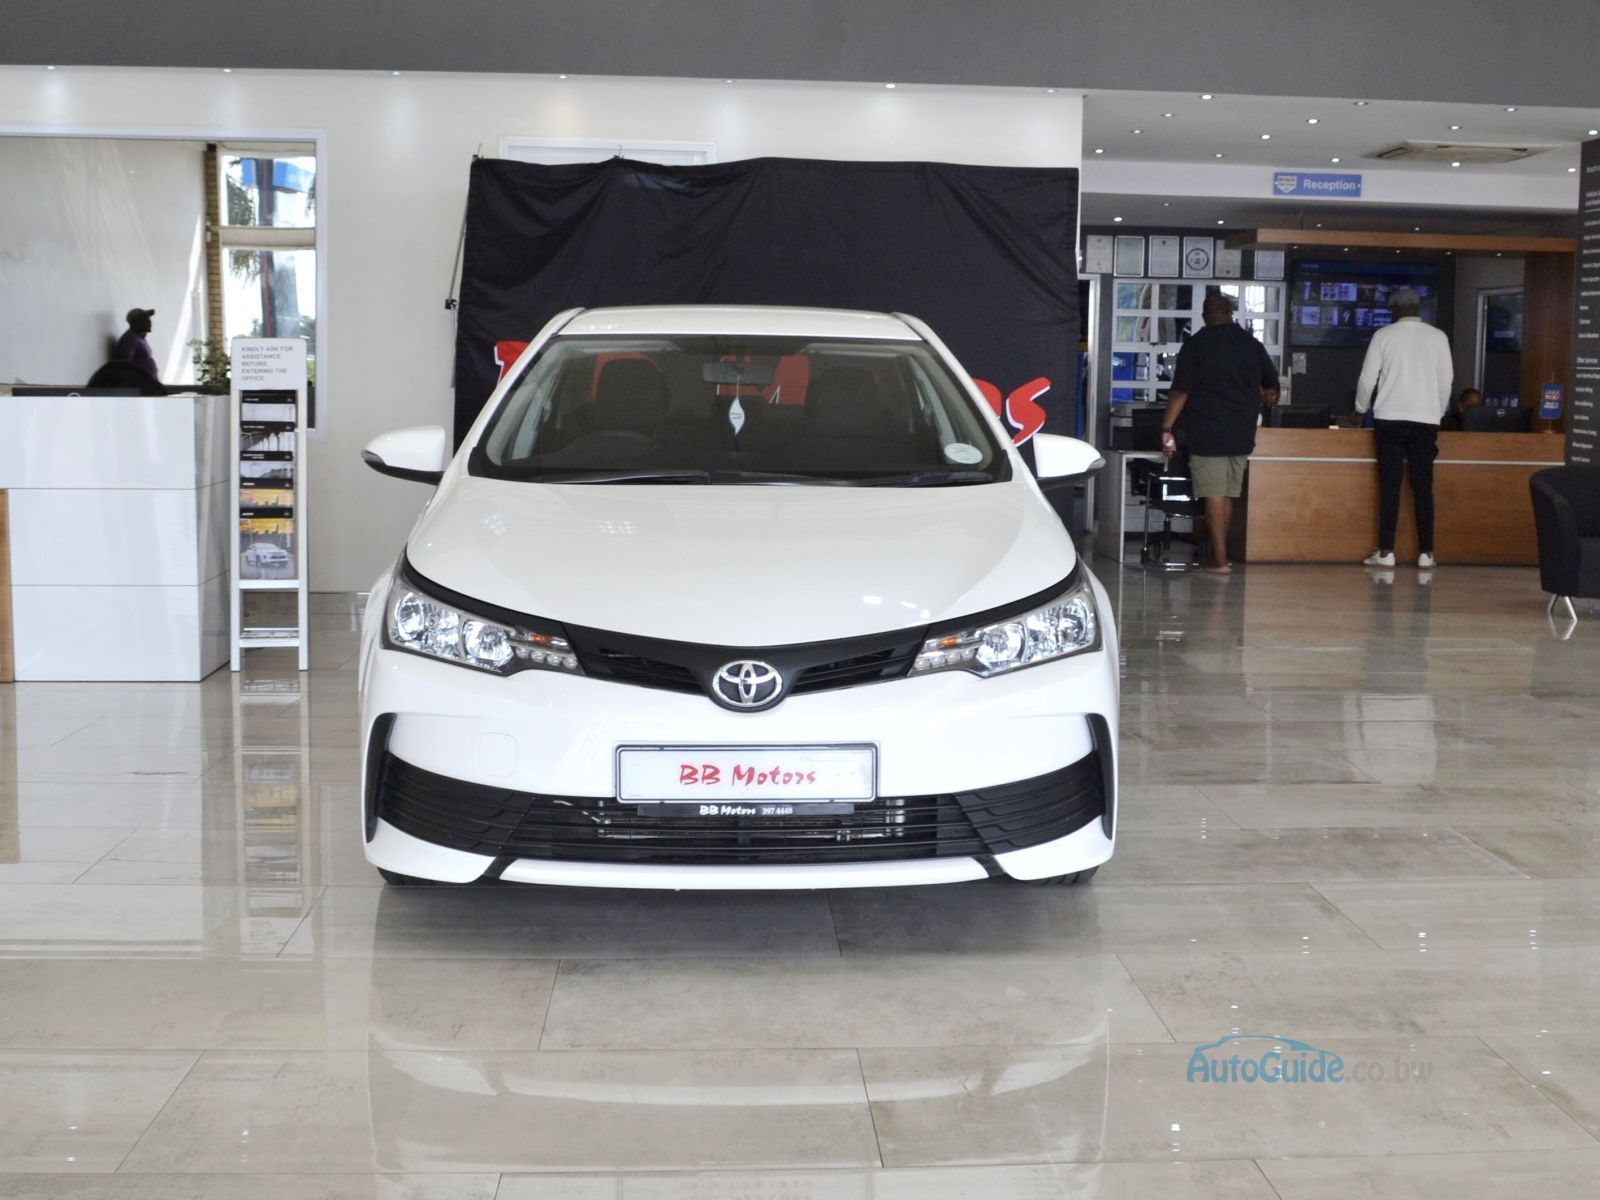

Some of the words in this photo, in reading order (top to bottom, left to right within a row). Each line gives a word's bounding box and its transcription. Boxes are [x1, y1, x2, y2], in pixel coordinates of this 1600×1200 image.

[1303, 178, 1356, 191] Reception
[680, 764, 720, 785] BB
[731, 764, 816, 786] Motors
[700, 805, 718, 815] BB
[721, 805, 756, 815] Motors
[762, 807, 775, 815] 397
